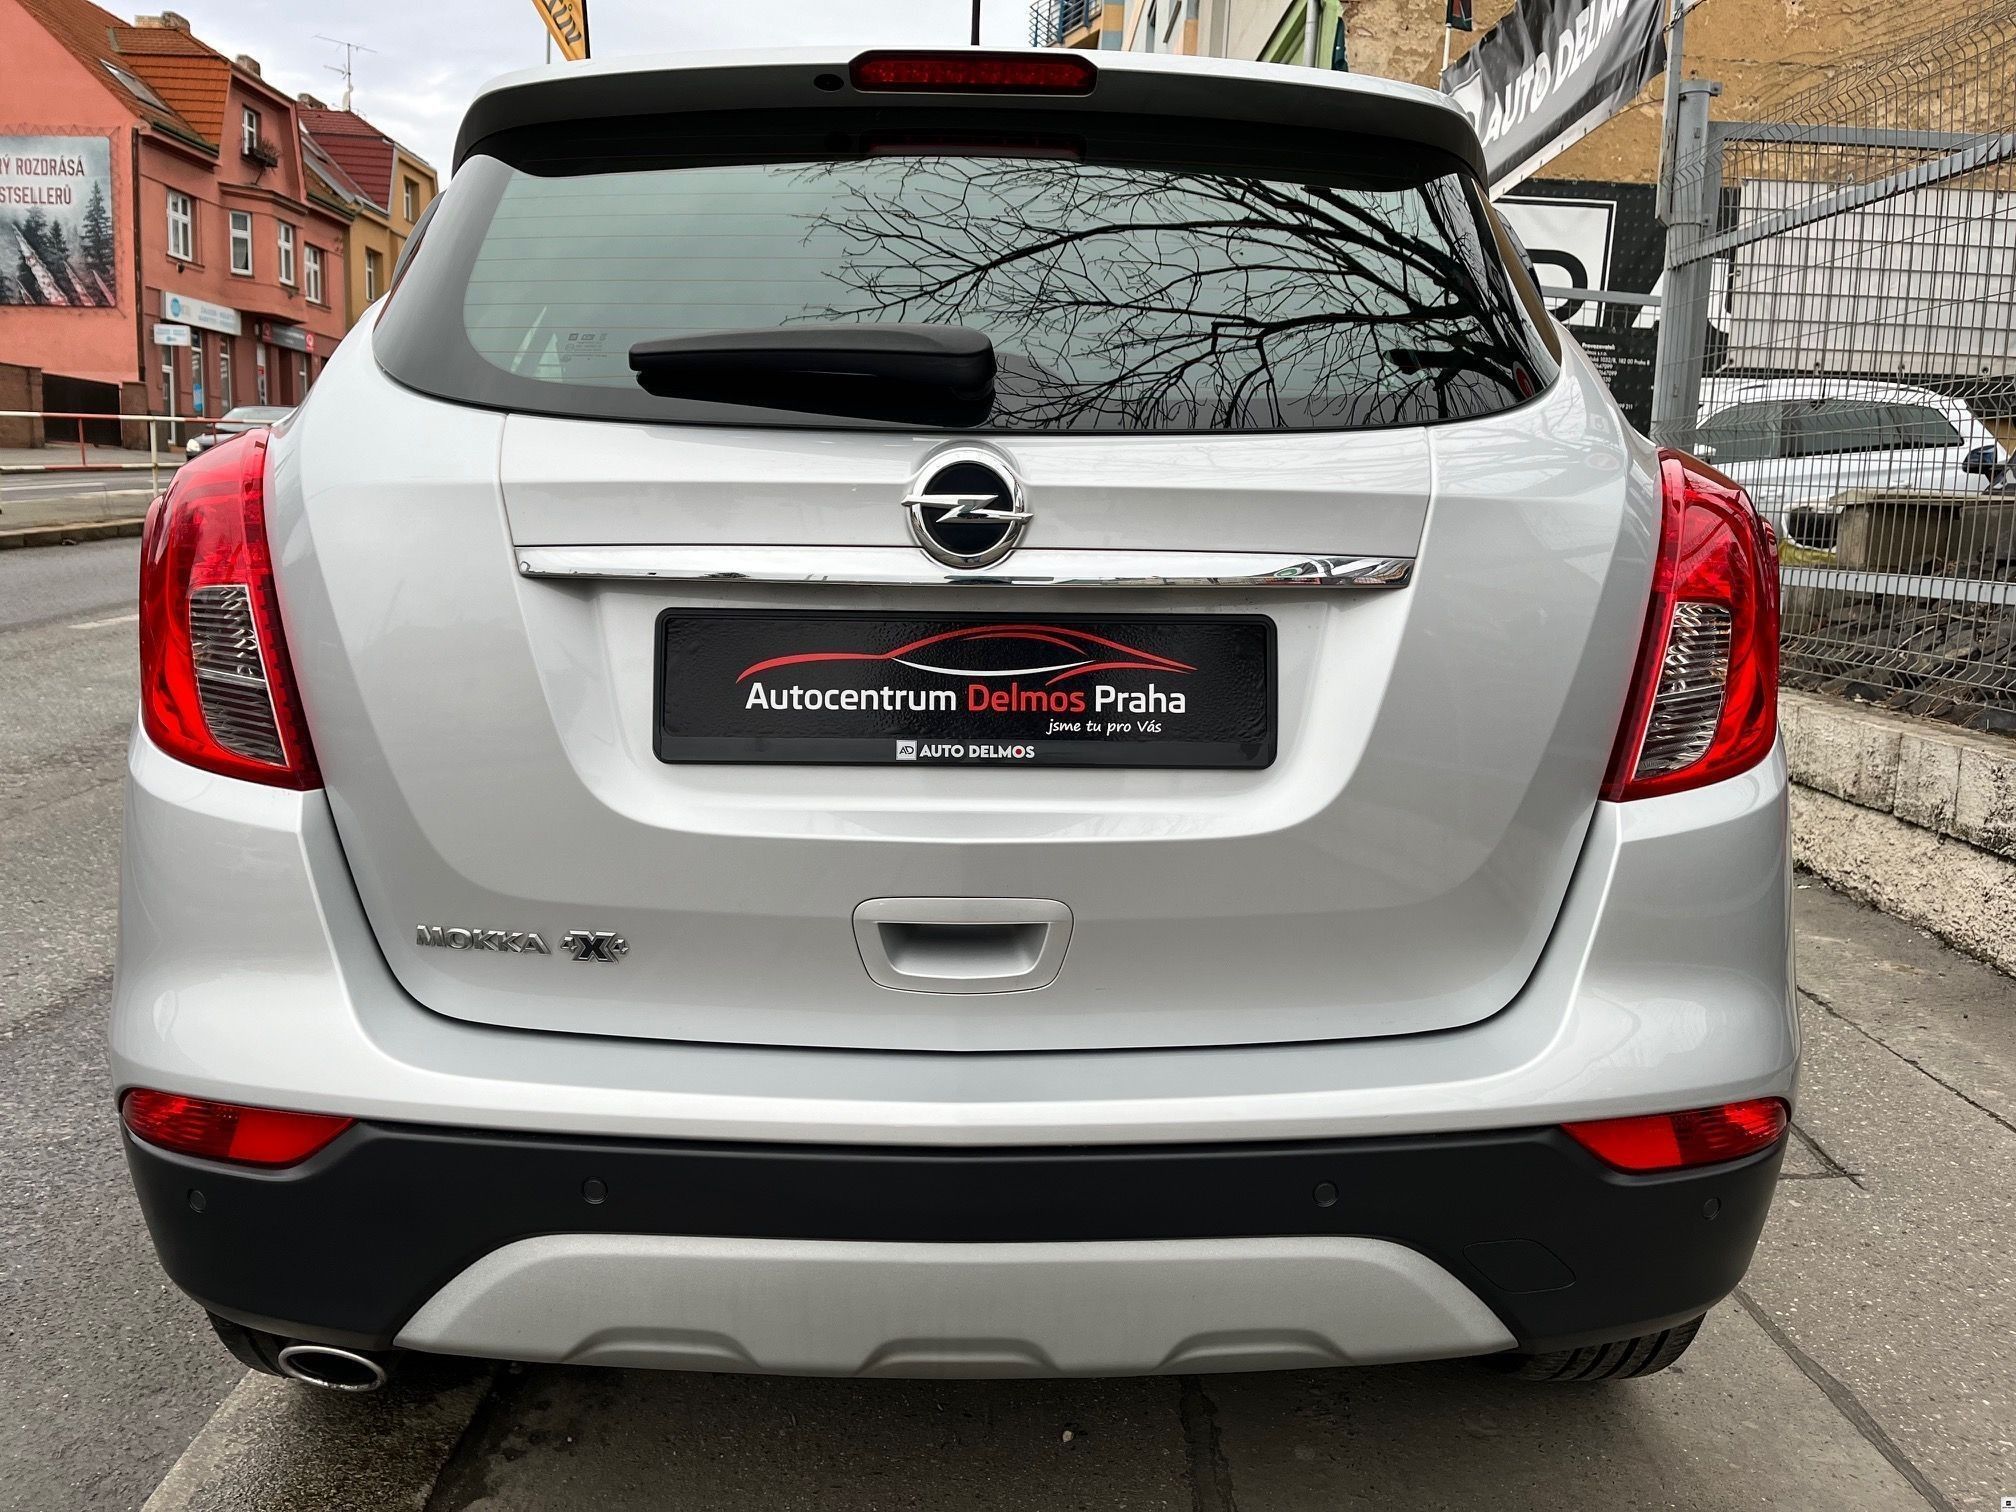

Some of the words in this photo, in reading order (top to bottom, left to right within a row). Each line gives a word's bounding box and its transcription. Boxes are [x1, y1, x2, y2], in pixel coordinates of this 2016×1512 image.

[1481, 52, 1551, 148] AUTO
[15, 155, 85, 176] ROZDRÁSÁ
[745, 682, 957, 711] Autocentrum
[968, 683, 1086, 713] Delmos
[1095, 683, 1186, 713] Praha
[1046, 718, 1081, 735] jsme
[1086, 720, 1102, 732] tu
[1106, 721, 1132, 736] pro
[1137, 720, 1162, 733] Vás
[919, 744, 965, 758] AUTO
[968, 745, 1036, 759] DELMOS
[416, 924, 552, 956] MOKKA
